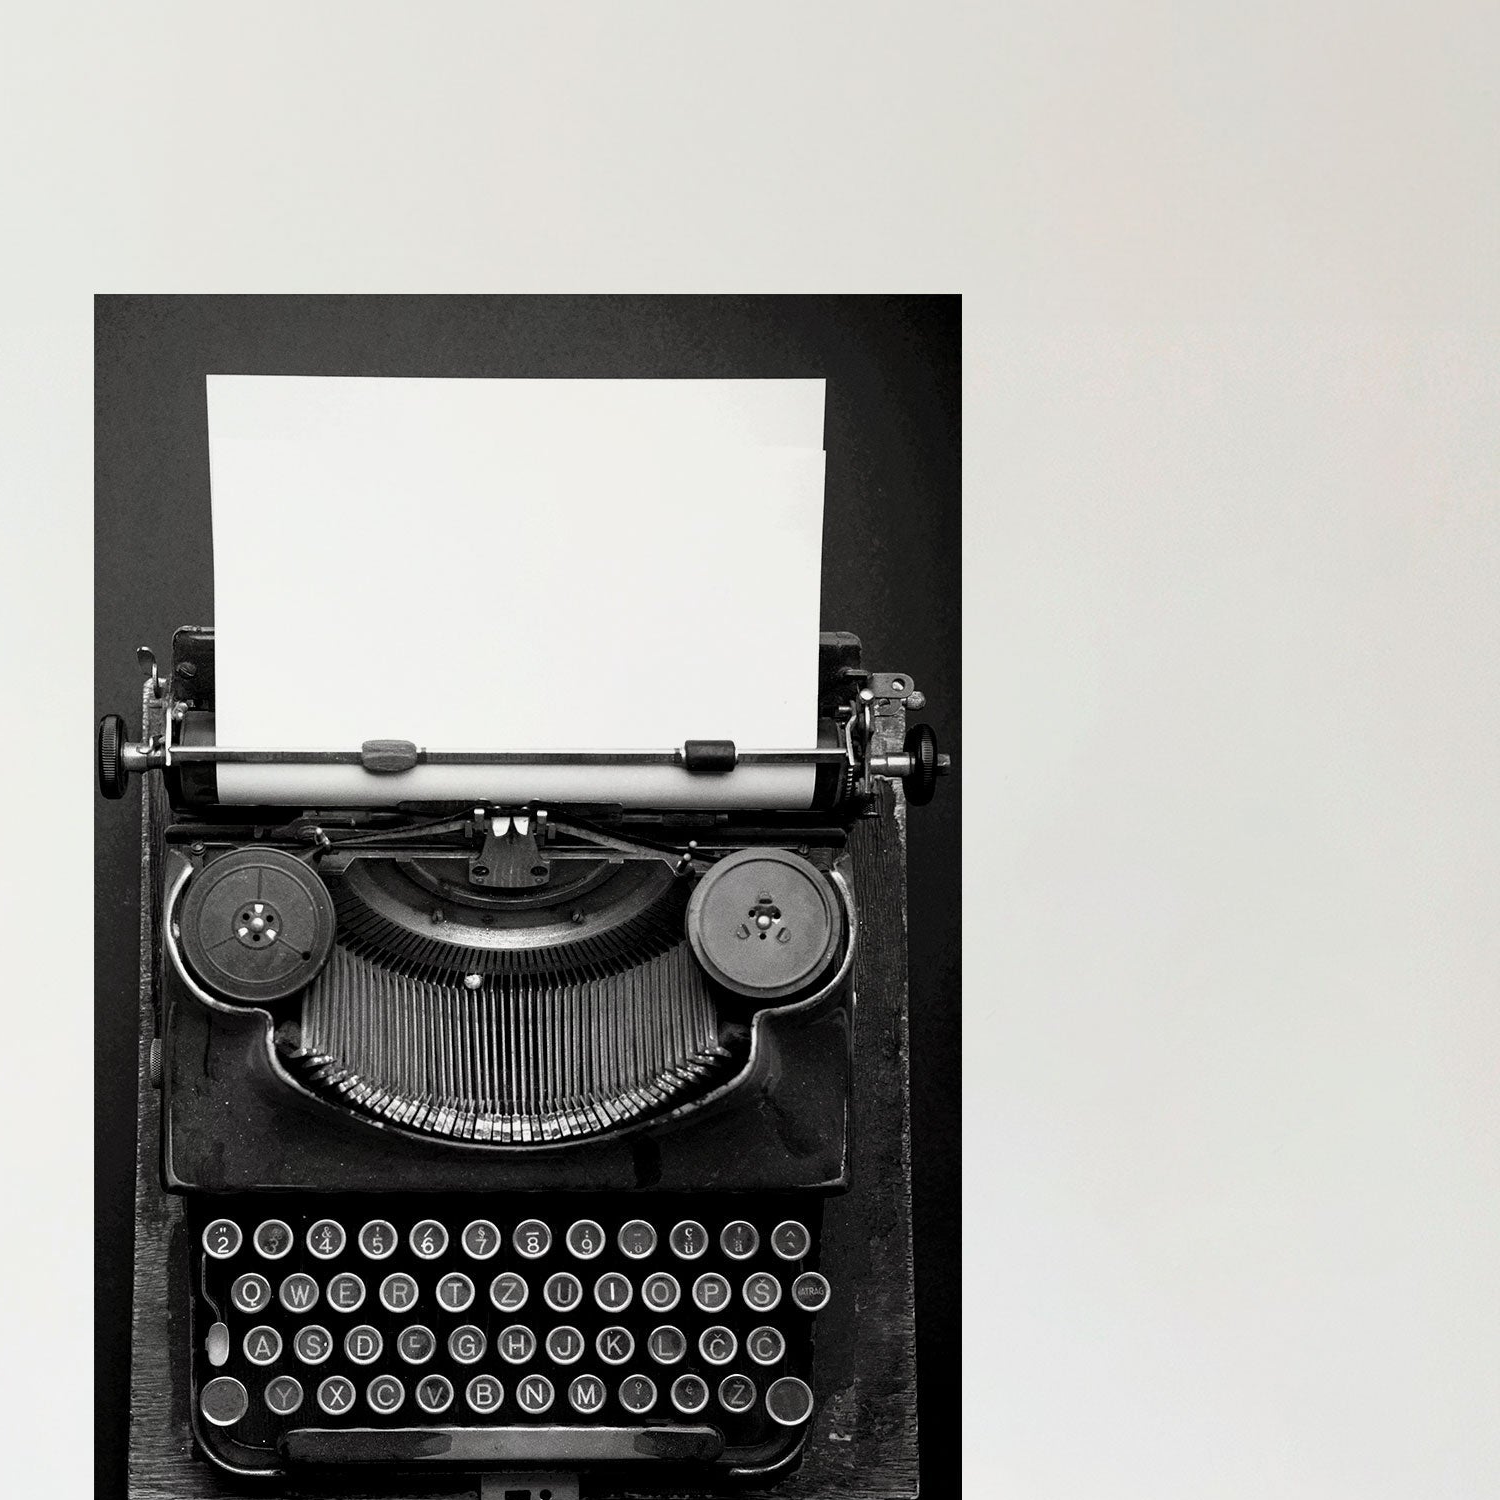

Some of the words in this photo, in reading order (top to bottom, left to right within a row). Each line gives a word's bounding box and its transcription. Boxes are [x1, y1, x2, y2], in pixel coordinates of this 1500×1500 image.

[217, 1236, 229, 1253] 2
[319, 1237, 333, 1253] 4
[372, 1237, 383, 1254] 5
[421, 1237, 433, 1254] 6
[475, 1239, 486, 1254] 7
[527, 1237, 540, 1253] 8
[581, 1238, 592, 1255] 9
[242, 1281, 261, 1306] Q
[290, 1284, 310, 1306] W
[339, 1283, 354, 1304] E
[393, 1283, 407, 1304] R
[447, 1283, 463, 1304] T
[501, 1282, 517, 1304] Z
[557, 1283, 572, 1304] U
[610, 1282, 615, 1301] I
[651, 1282, 670, 1304] O
[703, 1283, 719, 1304] P
[753, 1278, 770, 1305] Š
[254, 1336, 271, 1357] A
[306, 1335, 321, 1357] S
[357, 1336, 371, 1357] D
[458, 1335, 476, 1357] G
[509, 1335, 525, 1355] H
[557, 1336, 572, 1356] J
[607, 1335, 623, 1356] K
[658, 1335, 673, 1356] L
[275, 1386, 293, 1408] Y
[329, 1385, 345, 1407] X
[377, 1385, 394, 1406] C
[427, 1386, 444, 1407] V
[476, 1384, 492, 1405] B
[526, 1384, 543, 1404] N
[577, 1384, 596, 1404] M
